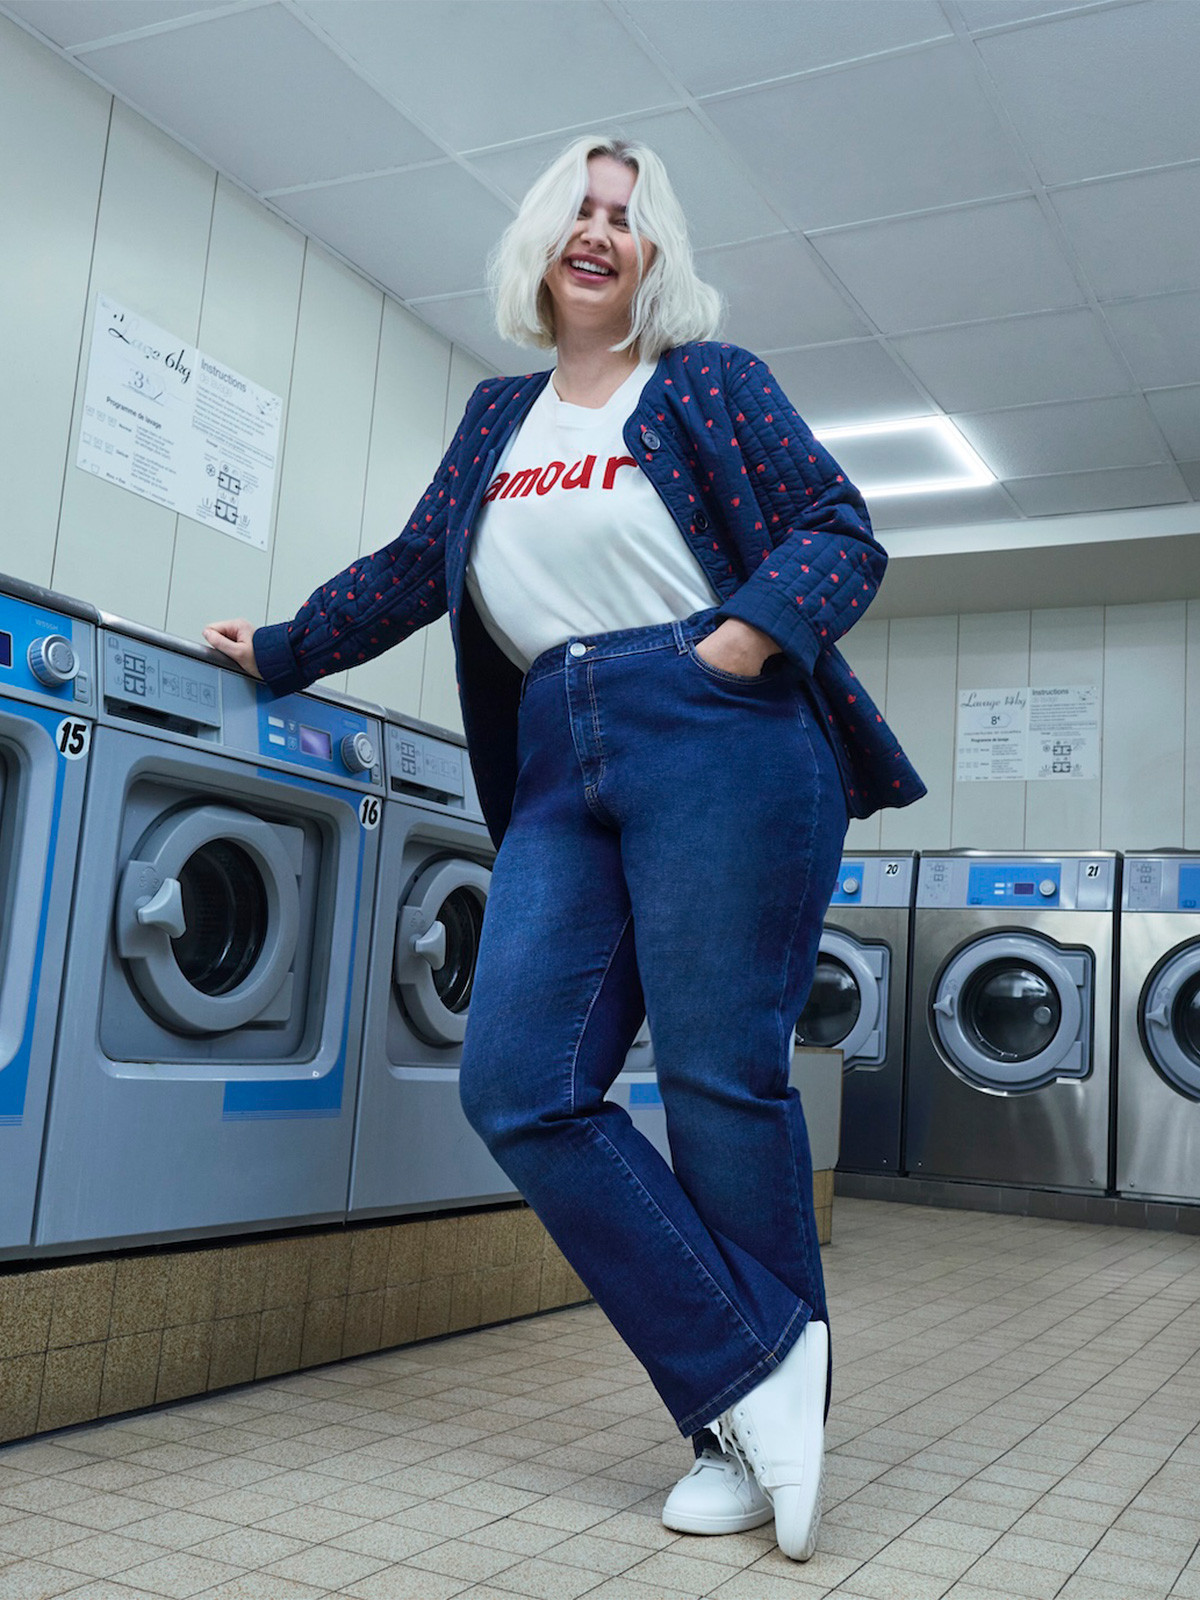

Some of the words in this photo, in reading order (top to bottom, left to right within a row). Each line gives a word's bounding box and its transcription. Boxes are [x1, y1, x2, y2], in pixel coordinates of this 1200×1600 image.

[165, 348, 192, 384] 6kg
[201, 358, 247, 392] Instructions
[106, 396, 137, 417] Programme
[482, 455, 638, 507] amour
[60, 721, 86, 755] 15
[362, 799, 378, 824] 16
[886, 863, 899, 875] 20
[1088, 866, 1099, 877] 21
